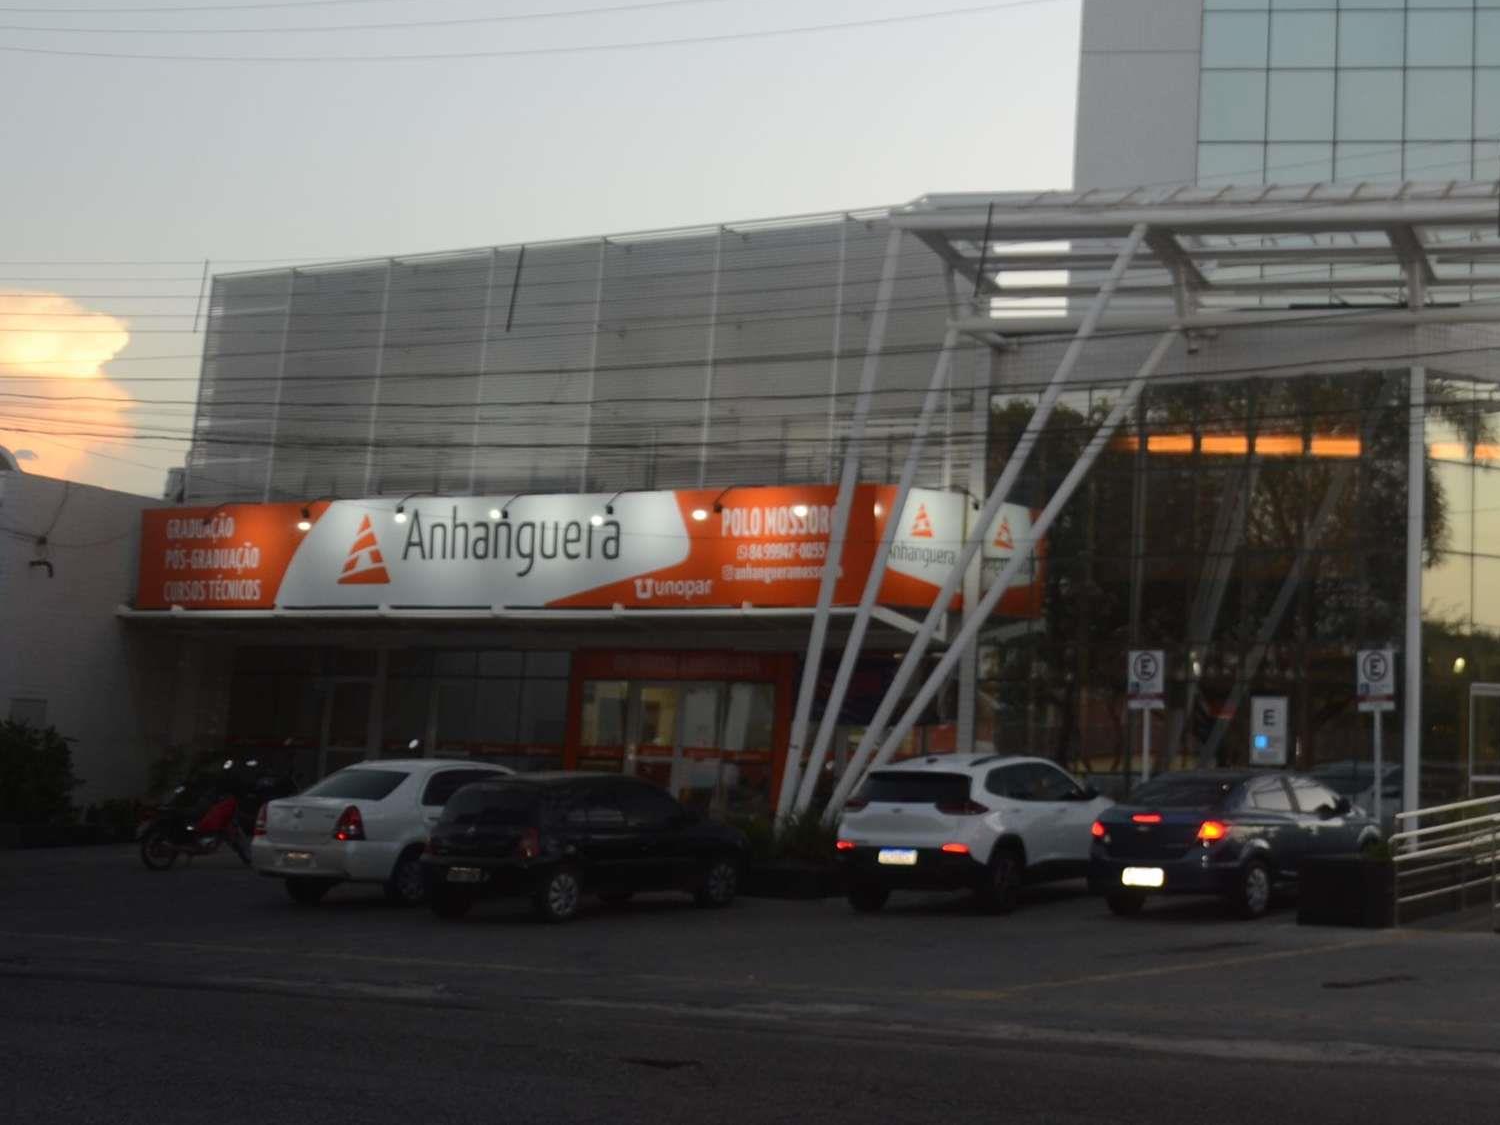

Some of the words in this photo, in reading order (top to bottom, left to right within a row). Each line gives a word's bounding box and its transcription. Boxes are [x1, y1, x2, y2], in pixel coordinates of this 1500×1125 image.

[166, 513, 236, 543] GRADUAÇÃO
[721, 506, 762, 537] POLO
[402, 505, 622, 577] Anhanguera
[164, 542, 261, 574] PÓS-GRADUAÇÃO
[163, 580, 205, 602] CURSOS
[207, 574, 262, 600] TÉCNICOS
[655, 579, 713, 601] unopar
